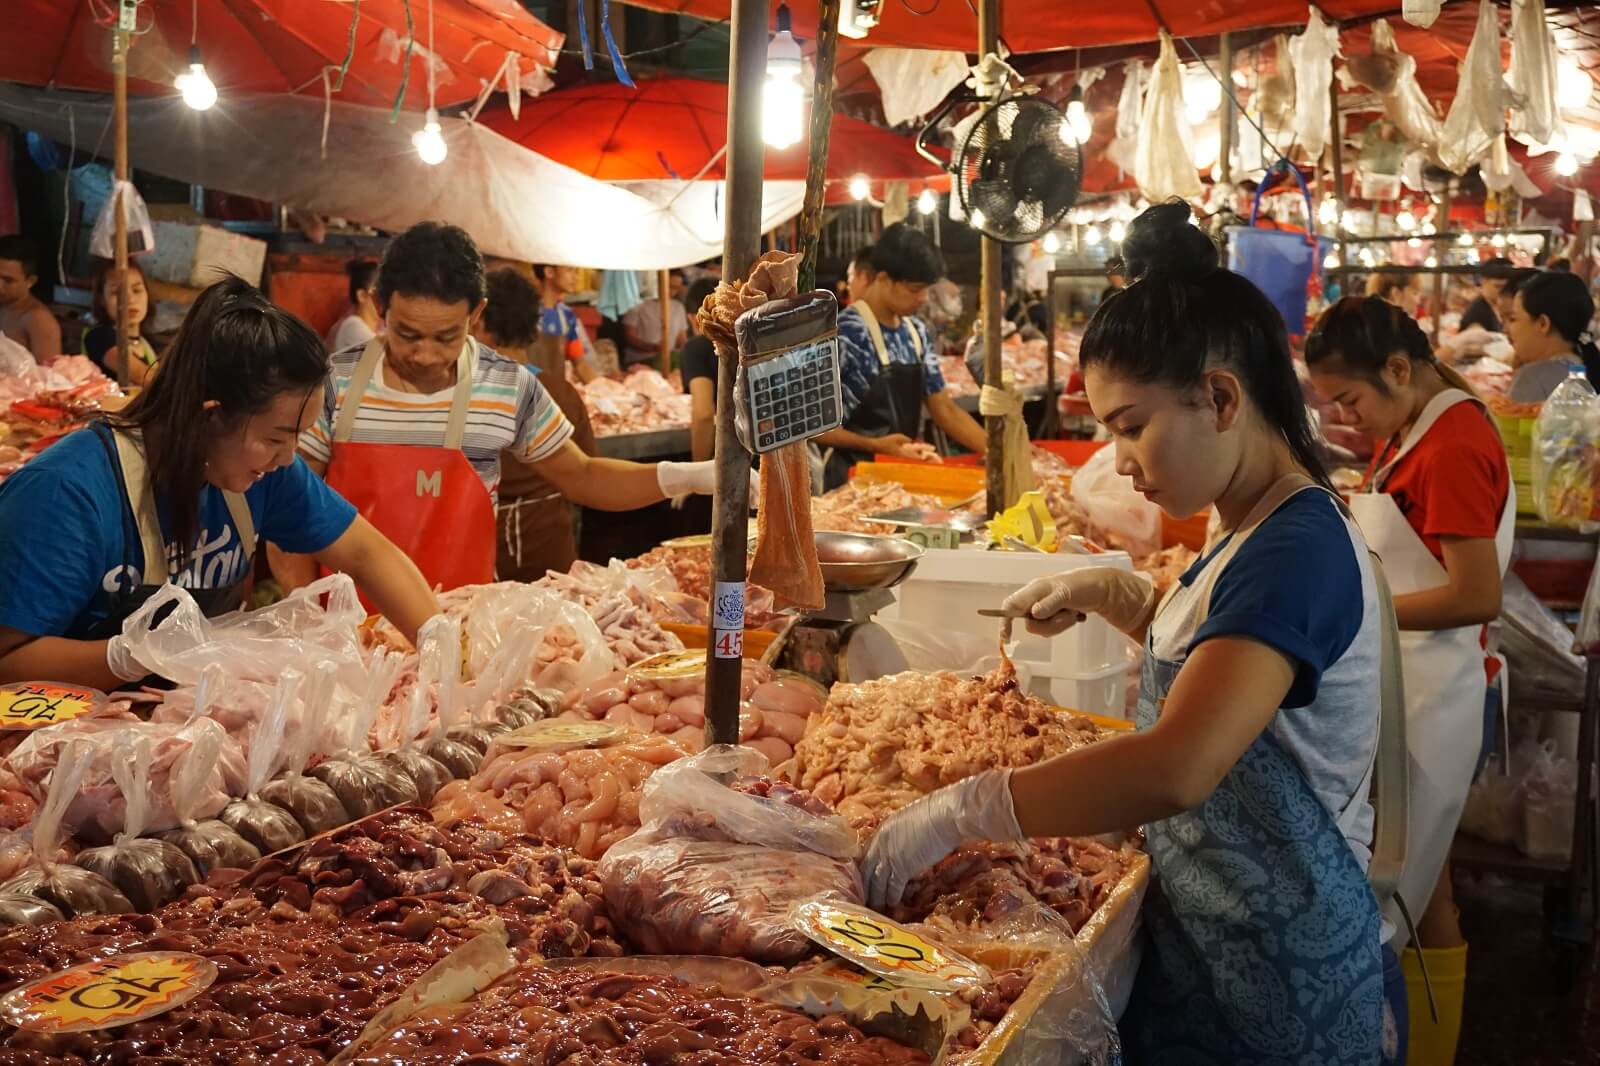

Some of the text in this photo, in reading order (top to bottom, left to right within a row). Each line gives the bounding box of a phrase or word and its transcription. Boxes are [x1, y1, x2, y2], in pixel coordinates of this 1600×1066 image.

[416, 469, 442, 497] M
[716, 632, 743, 656] 45
[2, 696, 63, 720] 75
